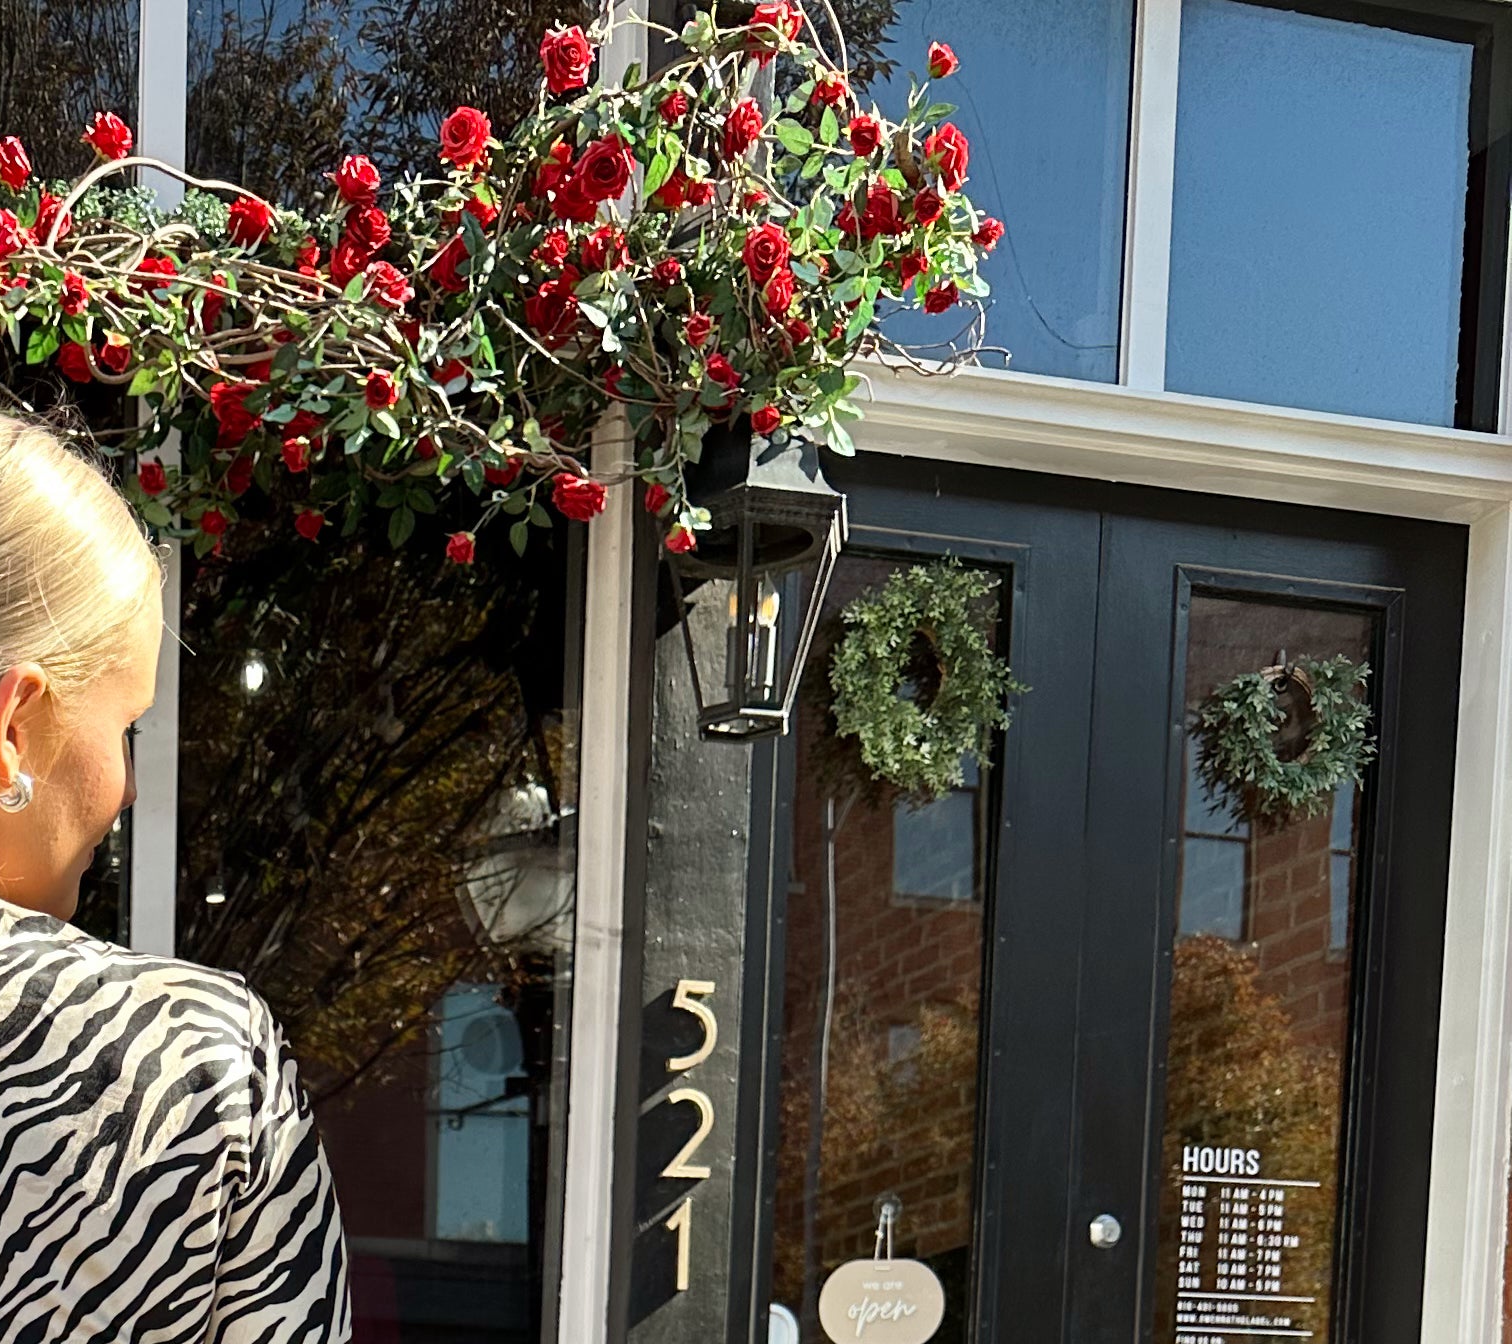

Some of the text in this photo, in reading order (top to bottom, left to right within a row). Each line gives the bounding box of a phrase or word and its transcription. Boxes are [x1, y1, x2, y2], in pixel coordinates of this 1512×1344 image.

[659, 979, 719, 1291] 521
[1182, 1146, 1261, 1175] HOURS
[1182, 1185, 1206, 1198] MON
[1221, 1187, 1231, 1199] 11
[1233, 1187, 1249, 1200] AM
[1259, 1188, 1266, 1201] 4
[1268, 1189, 1284, 1202] PM
[1182, 1200, 1203, 1213] TUE
[1220, 1202, 1230, 1214] 11
[1232, 1202, 1249, 1215] AM
[1267, 1204, 1284, 1217] PM
[1181, 1215, 1205, 1228] WED
[1219, 1217, 1230, 1229] 11
[1232, 1217, 1248, 1230] AM
[1266, 1219, 1283, 1232] PM
[1180, 1230, 1203, 1243] THU
[1219, 1232, 1229, 1244] 11
[1231, 1232, 1248, 1245] AM
[1283, 1235, 1299, 1248] PM
[1179, 1245, 1199, 1258] FRI
[1218, 1247, 1228, 1259] 11
[1230, 1247, 1247, 1260] AM
[1257, 1249, 1263, 1261] 7
[1264, 1249, 1281, 1262] PM
[1179, 1260, 1200, 1273] SAT
[1217, 1262, 1229, 1275] 10
[1230, 1263, 1247, 1276] AM
[1257, 1264, 1263, 1277] 7
[1265, 1264, 1281, 1277] PM
[863, 1281, 903, 1290] we are
[1178, 1276, 1201, 1289] SUN
[1217, 1278, 1229, 1290] 10
[1229, 1278, 1246, 1291] AM
[1264, 1279, 1281, 1292] PM
[847, 1296, 917, 1338] open
